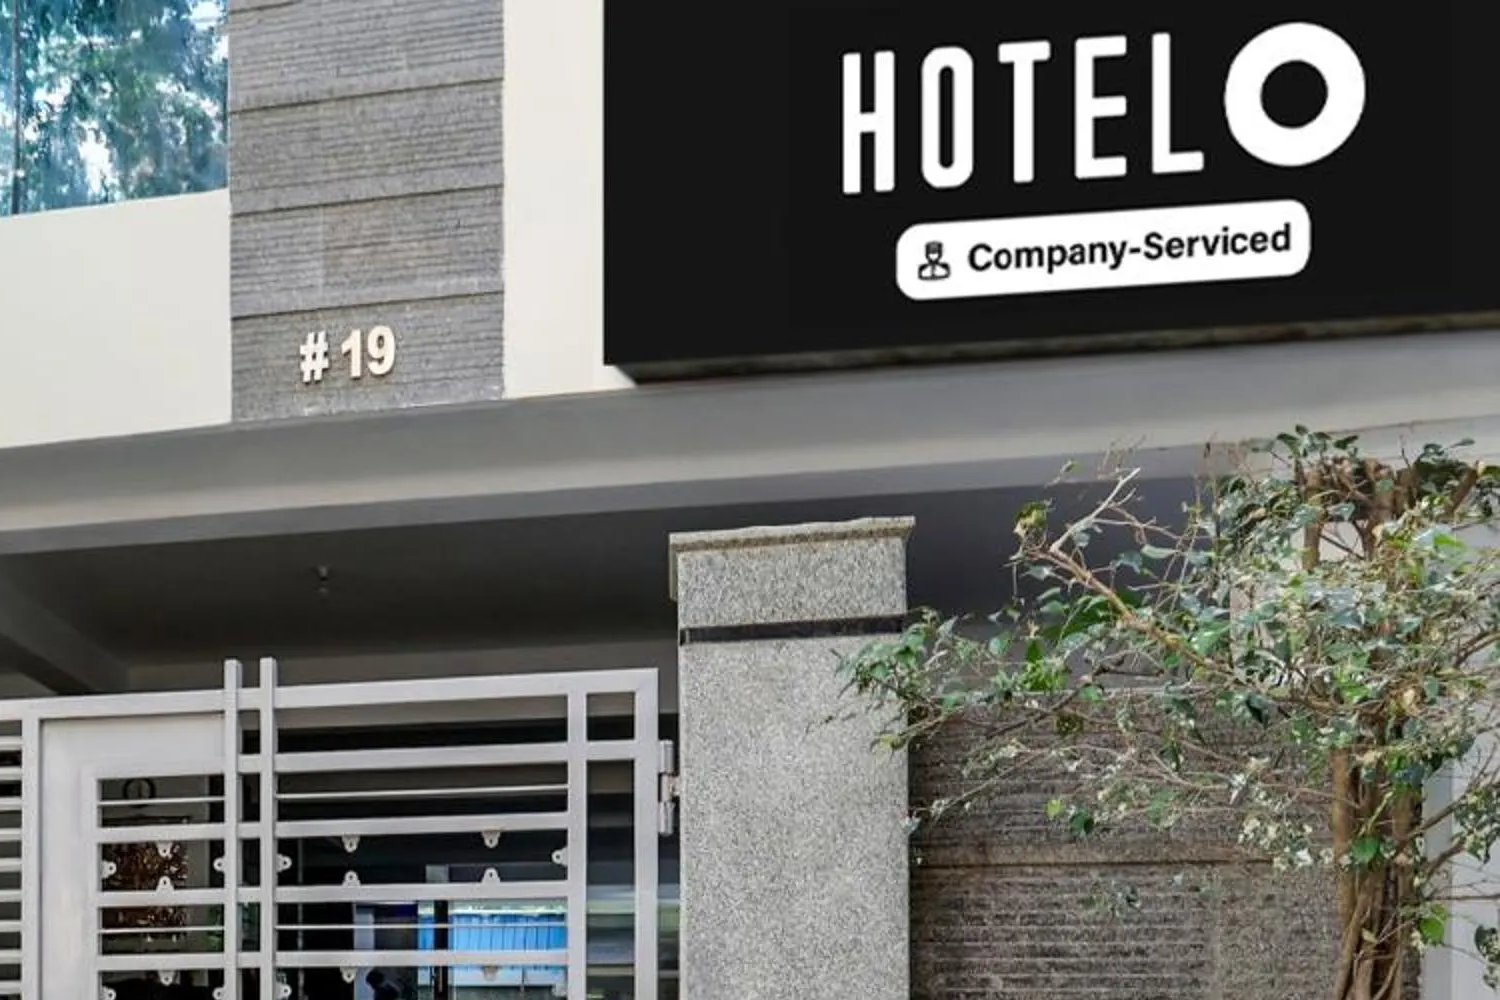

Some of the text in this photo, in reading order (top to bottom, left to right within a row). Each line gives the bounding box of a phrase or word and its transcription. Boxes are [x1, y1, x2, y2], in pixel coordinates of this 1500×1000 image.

[842, 21, 1367, 195] HOTEL O
[967, 222, 1293, 275] Company-Serviced
